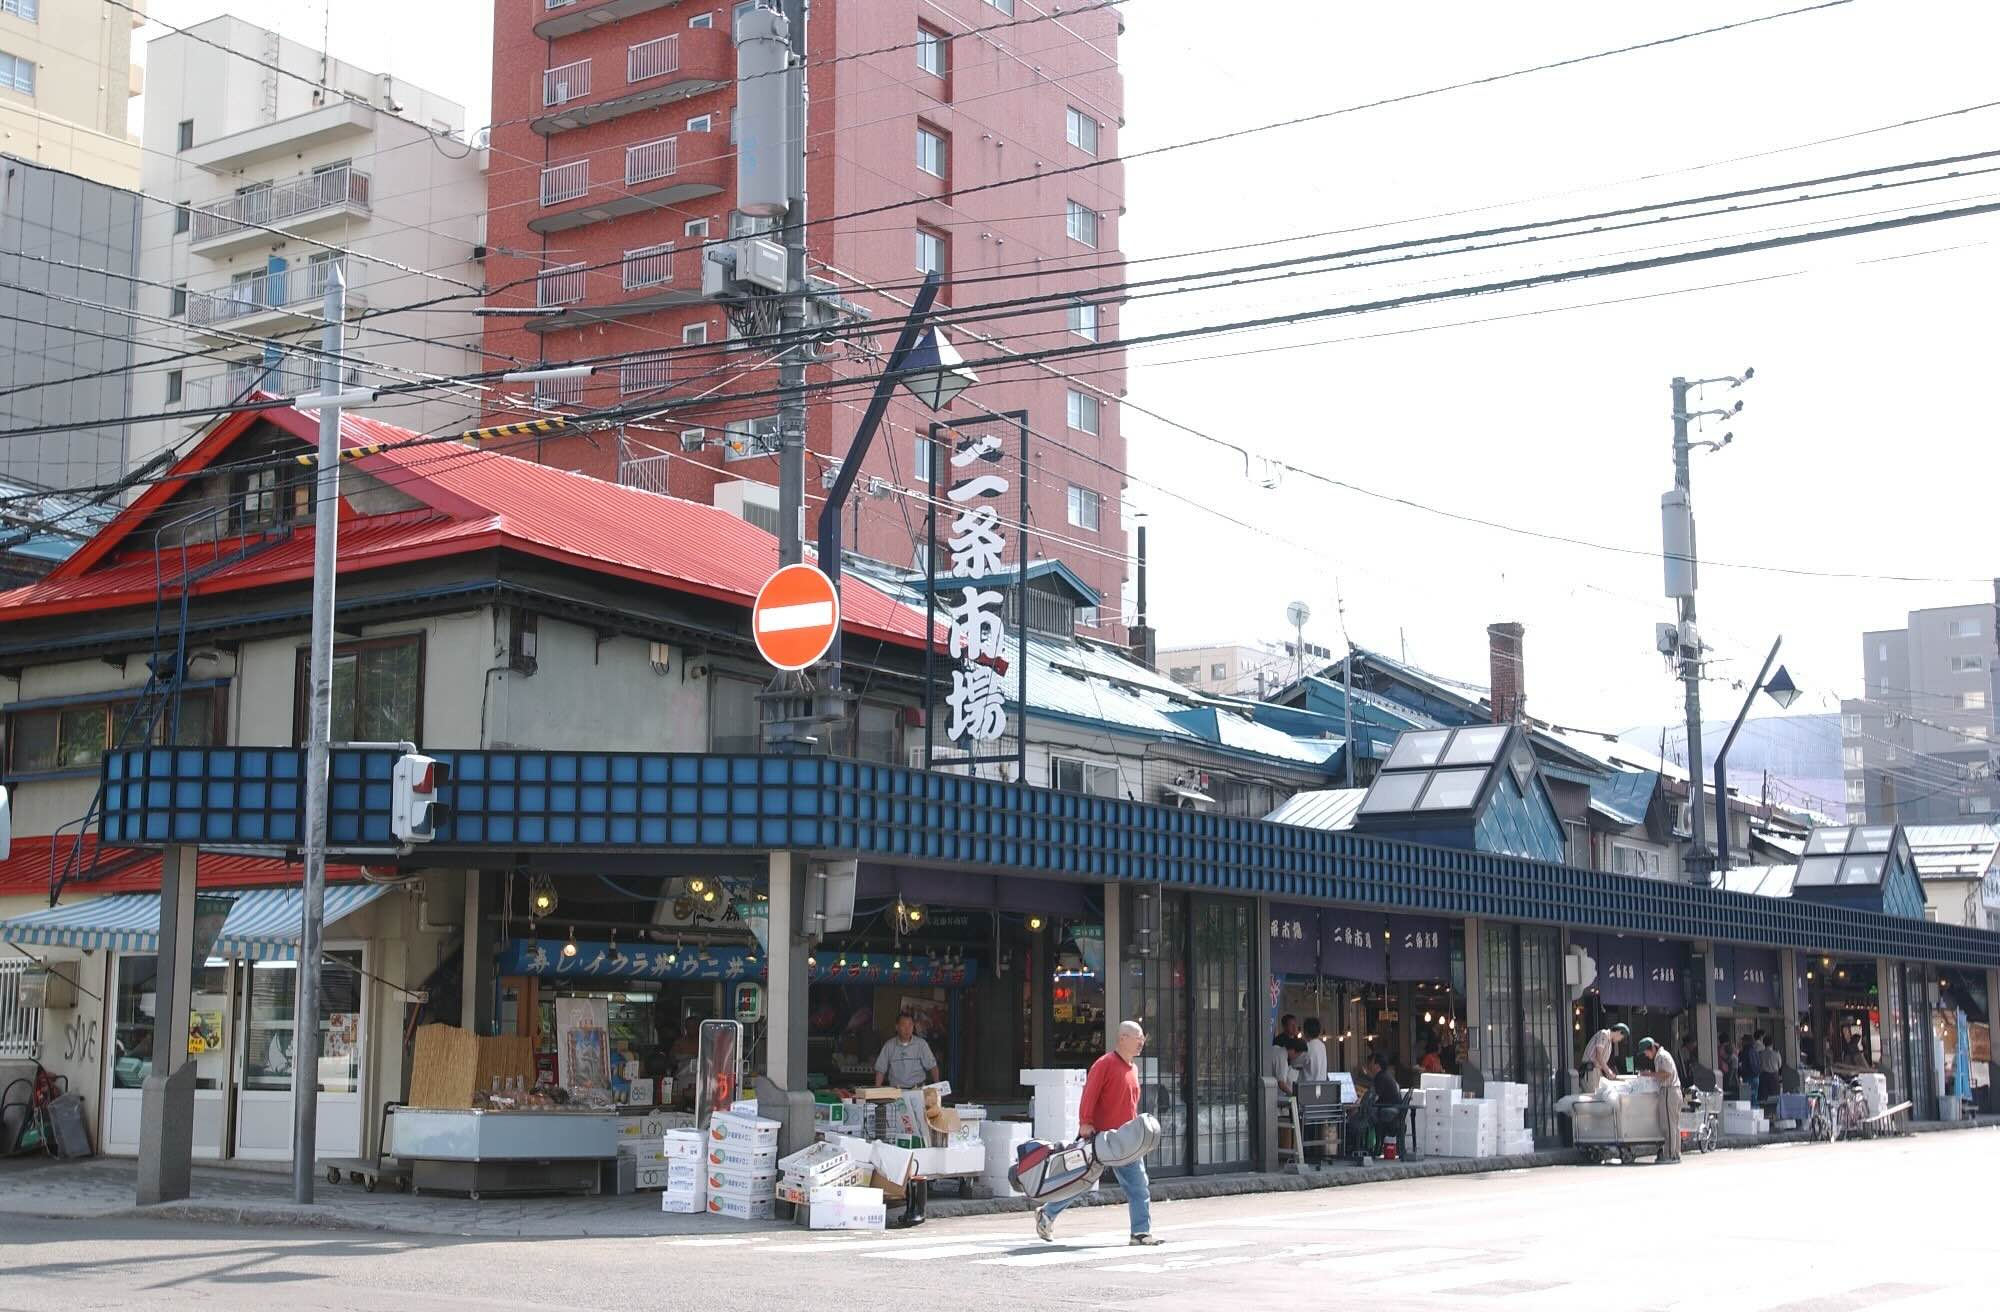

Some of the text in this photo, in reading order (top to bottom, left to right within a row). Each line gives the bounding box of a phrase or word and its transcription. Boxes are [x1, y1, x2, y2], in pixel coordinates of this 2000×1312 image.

[946, 435, 1009, 741] 二条市場
[1270, 919, 1302, 940] 条市場
